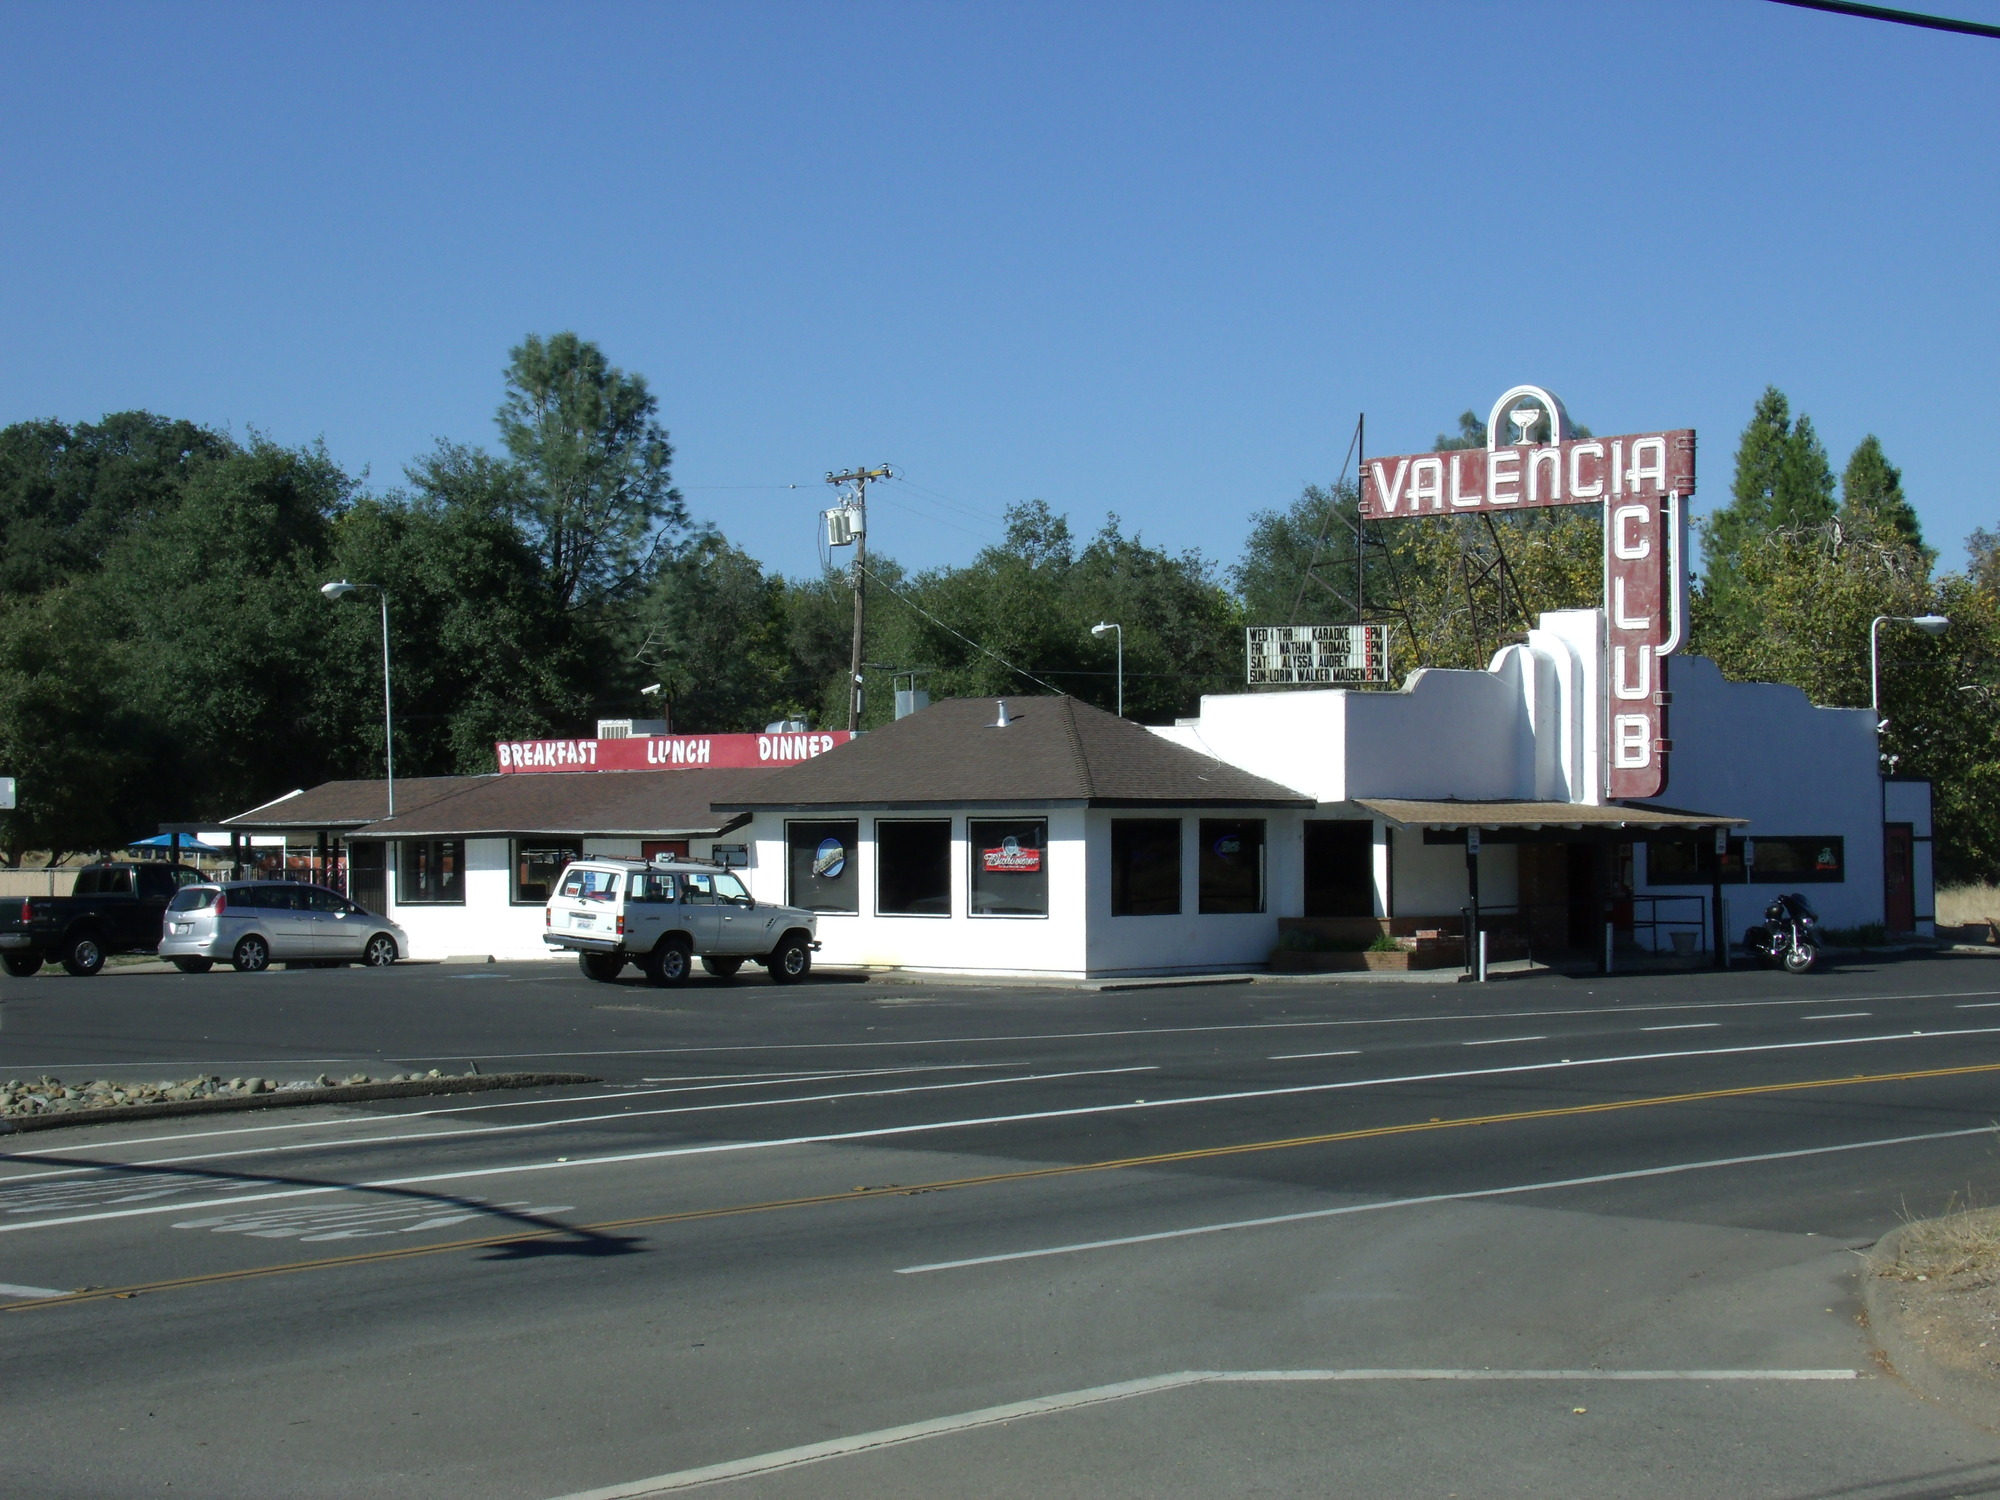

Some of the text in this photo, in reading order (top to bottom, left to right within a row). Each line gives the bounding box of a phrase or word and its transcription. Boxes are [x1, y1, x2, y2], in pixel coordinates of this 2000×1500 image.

[1371, 436, 1666, 513] VALENCIA
[1249, 628, 1267, 641] WED
[1312, 627, 1349, 640] KARAOKE
[1613, 504, 1651, 769] CLUB
[1280, 641, 1312, 654] NATHAN
[1318, 641, 1351, 654] THOMAS
[1282, 655, 1313, 668] ALYSSA
[1319, 655, 1349, 668] AUDREY
[1297, 668, 1330, 681] WALKER
[1333, 668, 1366, 681] MADSEN
[498, 741, 598, 767] BREAKFAST
[647, 739, 711, 764] LUNCH
